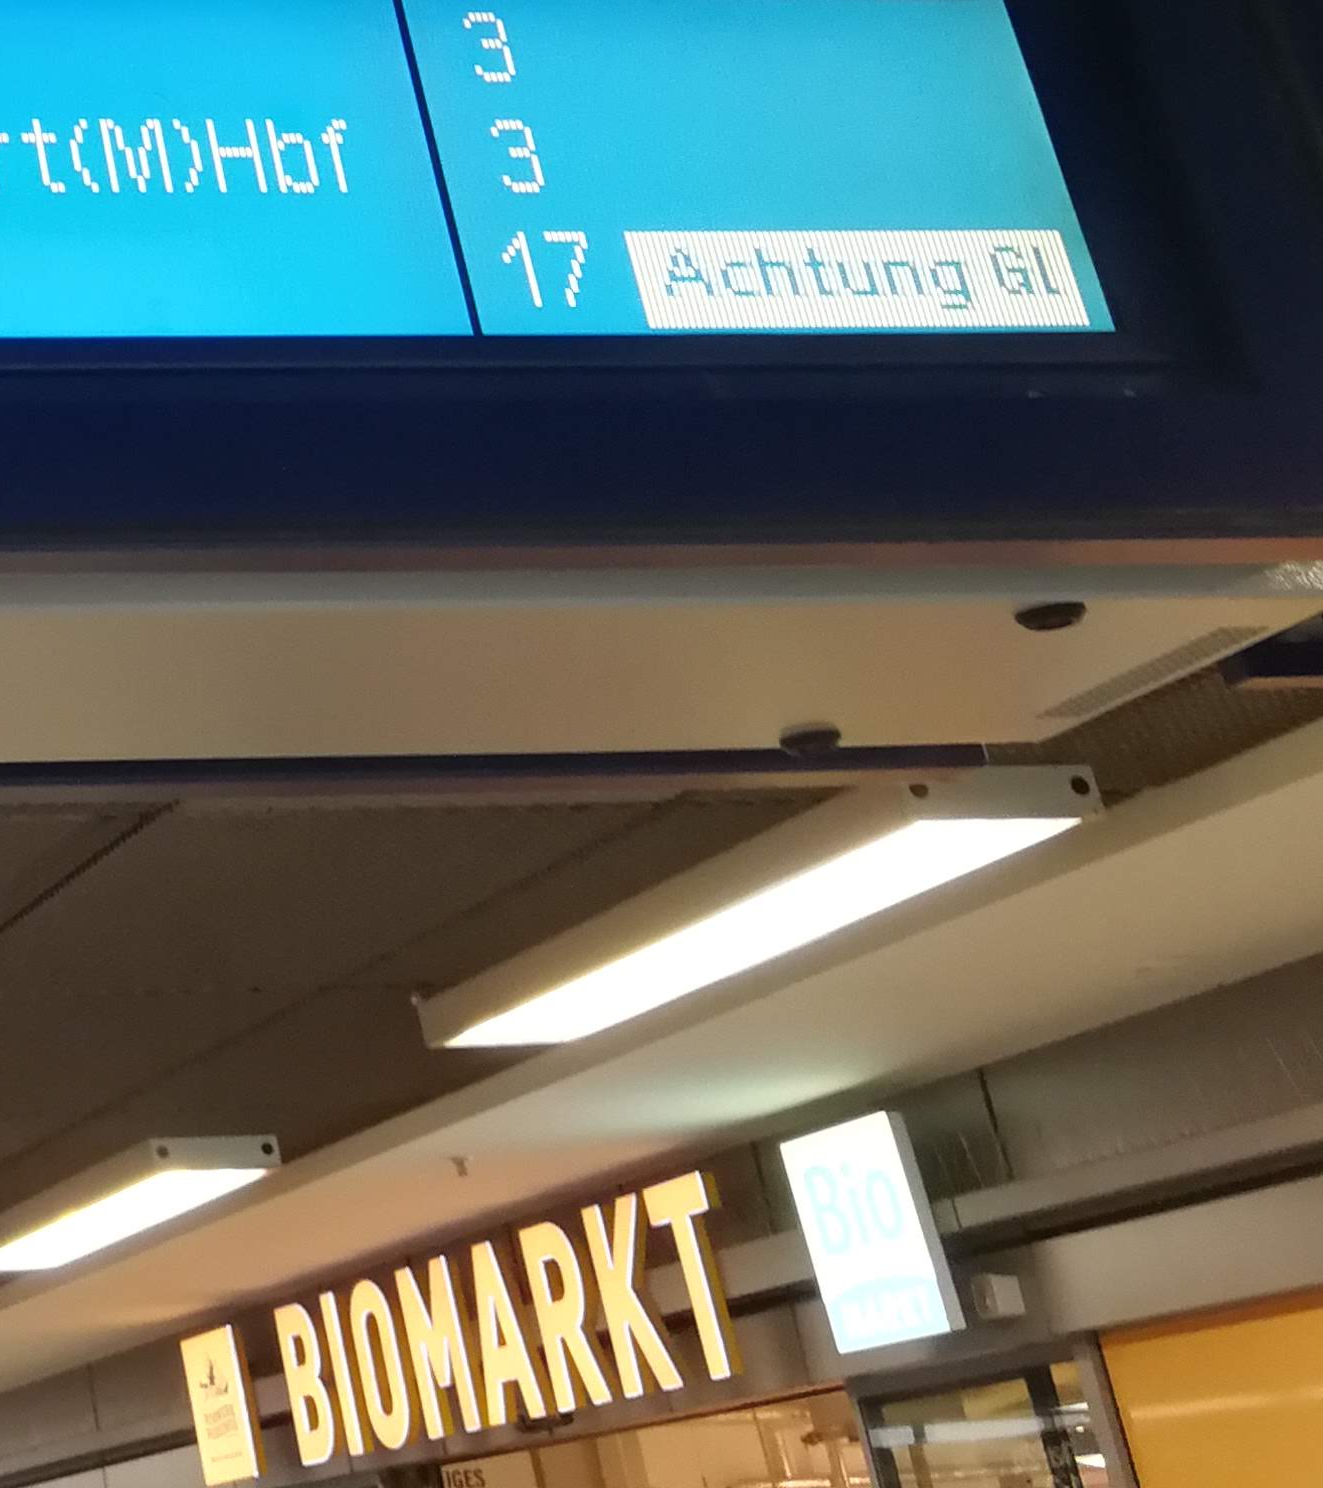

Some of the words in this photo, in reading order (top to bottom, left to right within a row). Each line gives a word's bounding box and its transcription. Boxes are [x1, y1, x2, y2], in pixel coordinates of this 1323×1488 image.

[464, 12, 515, 82] 3
[490, 119, 544, 193] 3
[502, 231, 587, 307] 17
[663, 245, 973, 310] Achtung
[989, 244, 1061, 297] Gl
[804, 1161, 903, 1254] Bio
[274, 1170, 731, 1467] BIOMARKT
